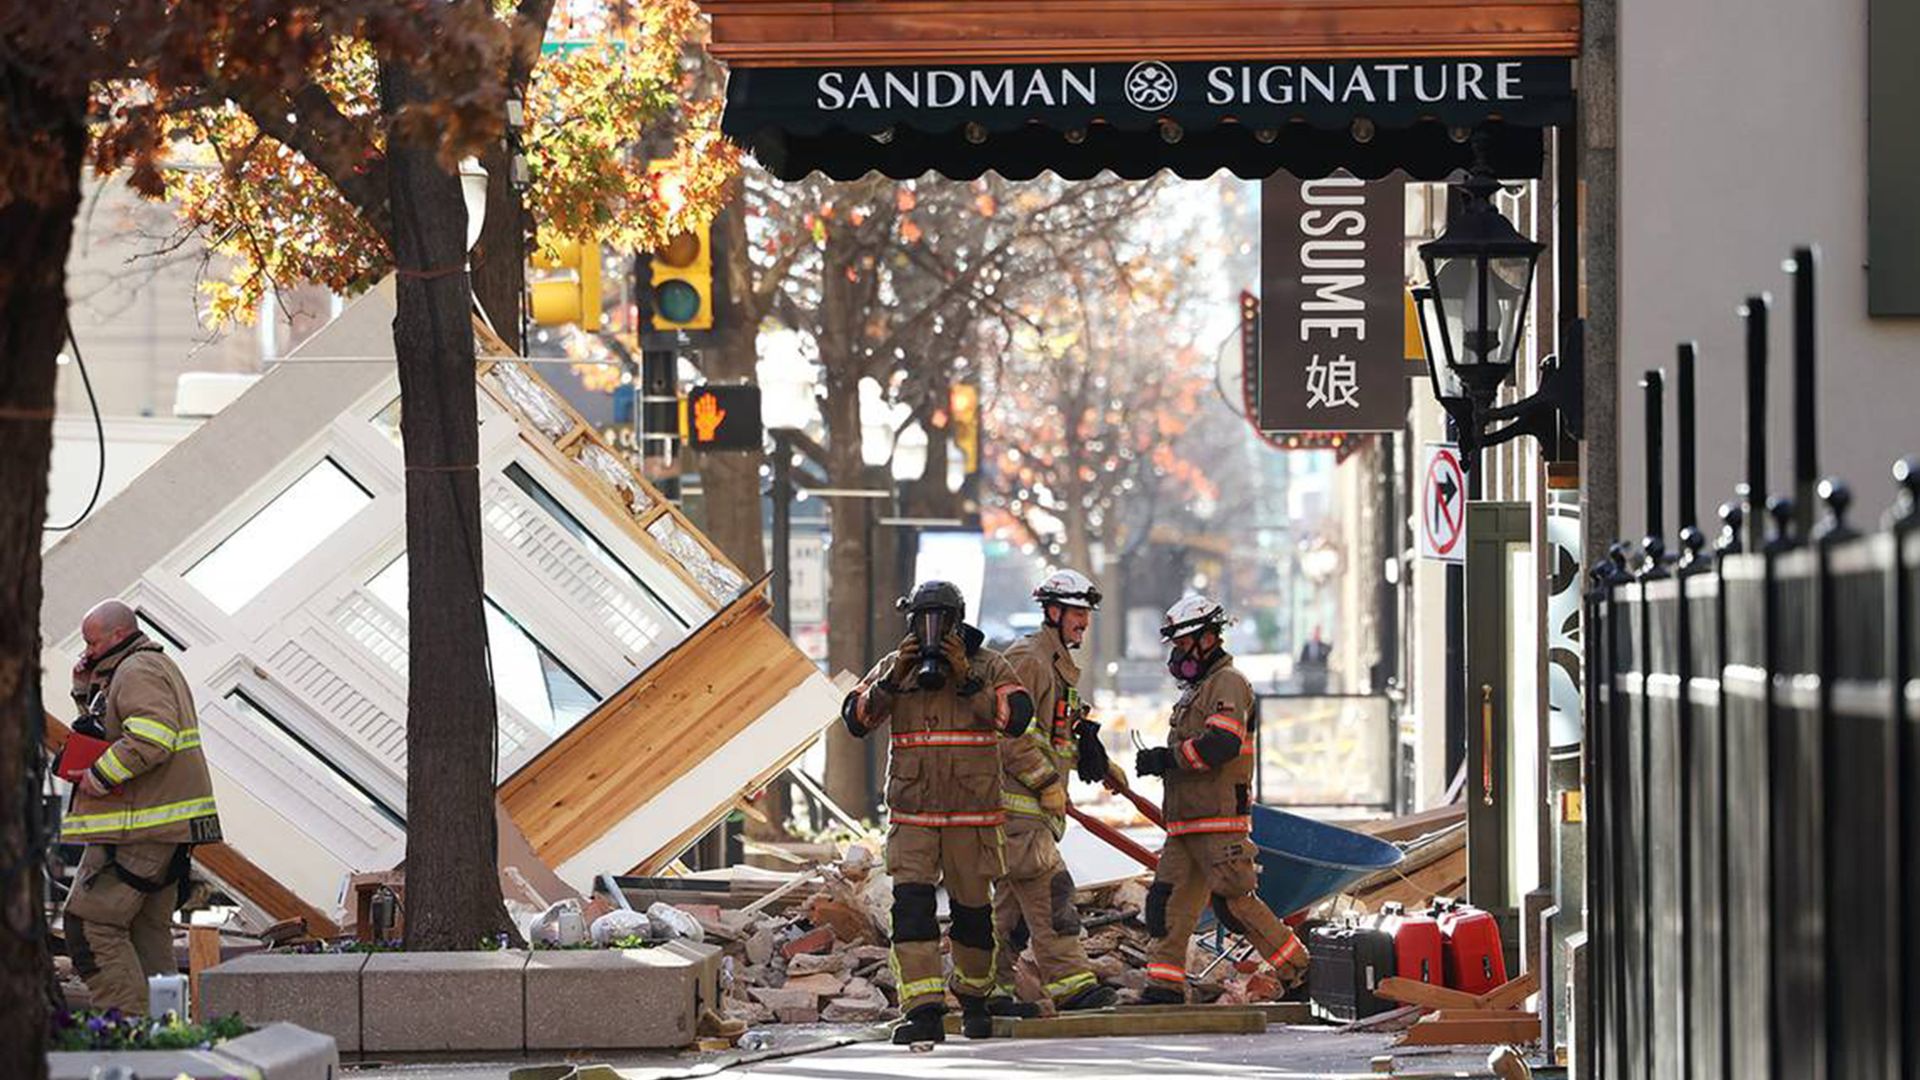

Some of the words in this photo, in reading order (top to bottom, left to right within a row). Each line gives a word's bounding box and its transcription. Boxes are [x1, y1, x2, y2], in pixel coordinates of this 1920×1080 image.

[817, 67, 1096, 111] SANDMAN
[1206, 61, 1524, 105] SIGNATURE
[1305, 354, 1360, 409] 娘
